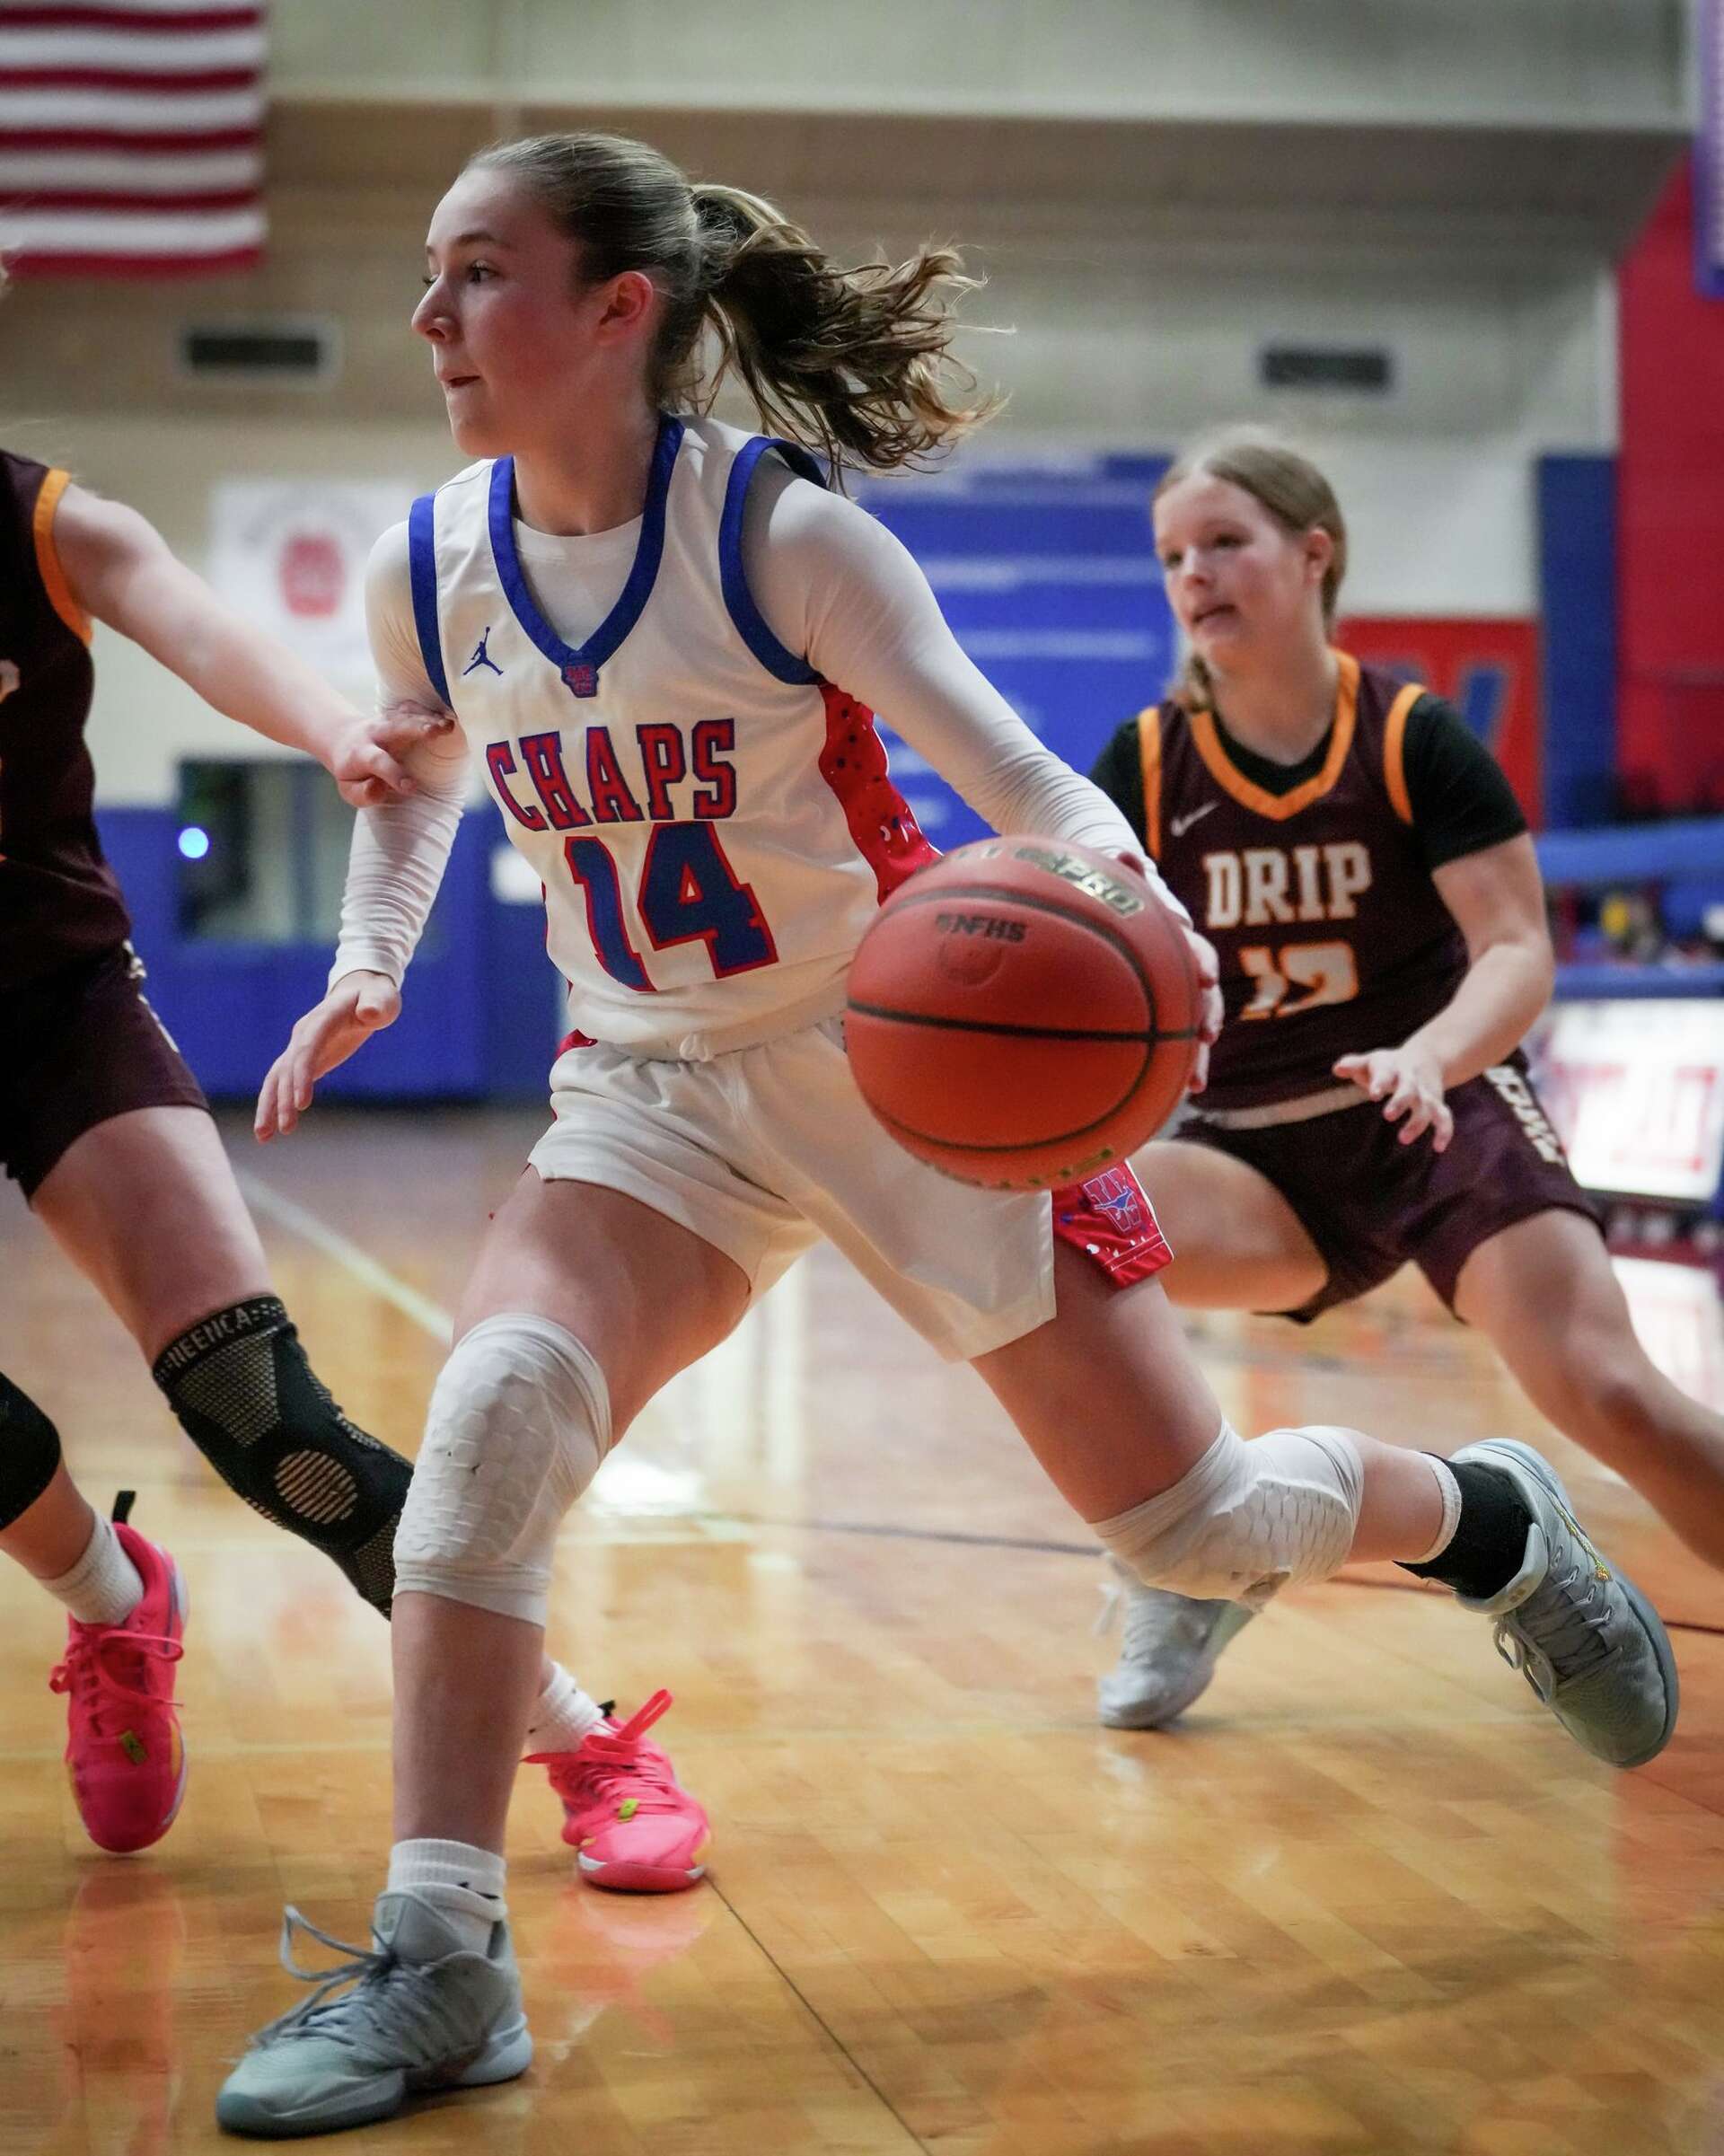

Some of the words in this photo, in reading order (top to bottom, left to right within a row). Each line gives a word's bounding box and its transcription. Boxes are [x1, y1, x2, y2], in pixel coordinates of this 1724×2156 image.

[486, 718, 737, 832] CHAPS
[564, 821, 779, 992] 14
[1203, 841, 1373, 930] DRIP
[167, 1307, 253, 1369] NEENCA
